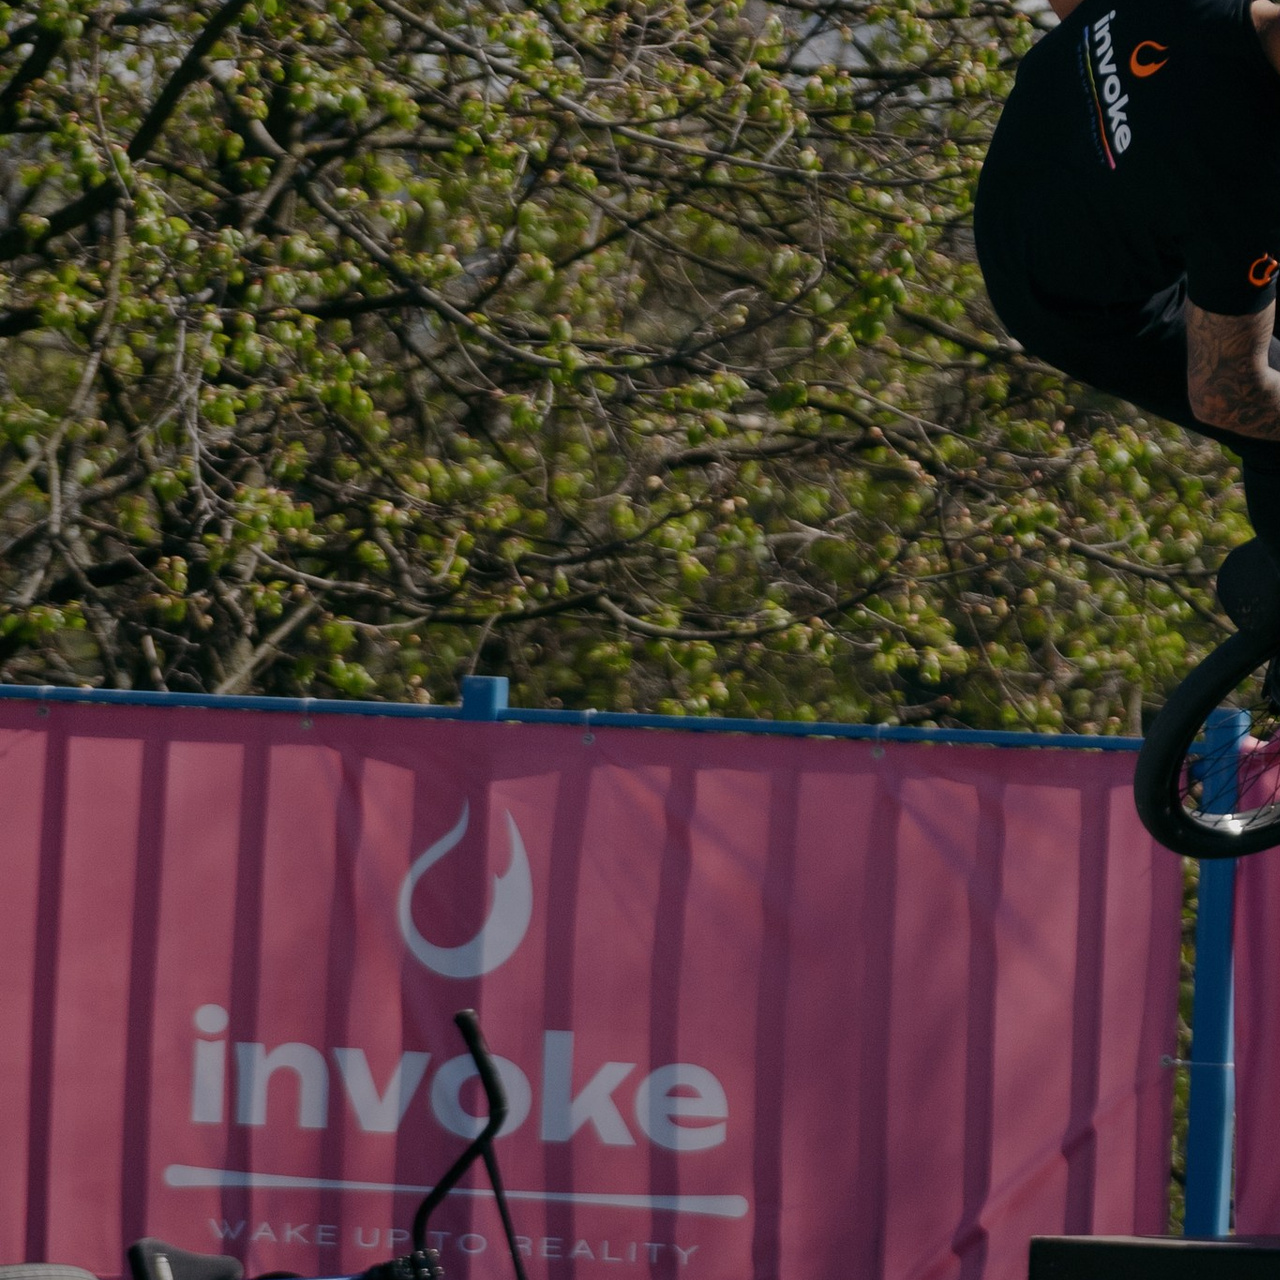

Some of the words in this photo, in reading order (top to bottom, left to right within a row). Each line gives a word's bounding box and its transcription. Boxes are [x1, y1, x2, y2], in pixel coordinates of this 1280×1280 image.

[1093, 9, 1132, 155] invoke
[190, 1004, 729, 1152] invoke
[208, 1218, 339, 1246] WAKE
[355, 1226, 411, 1249] UP
[429, 1230, 488, 1255] TO
[510, 1235, 700, 1265] REALITY
